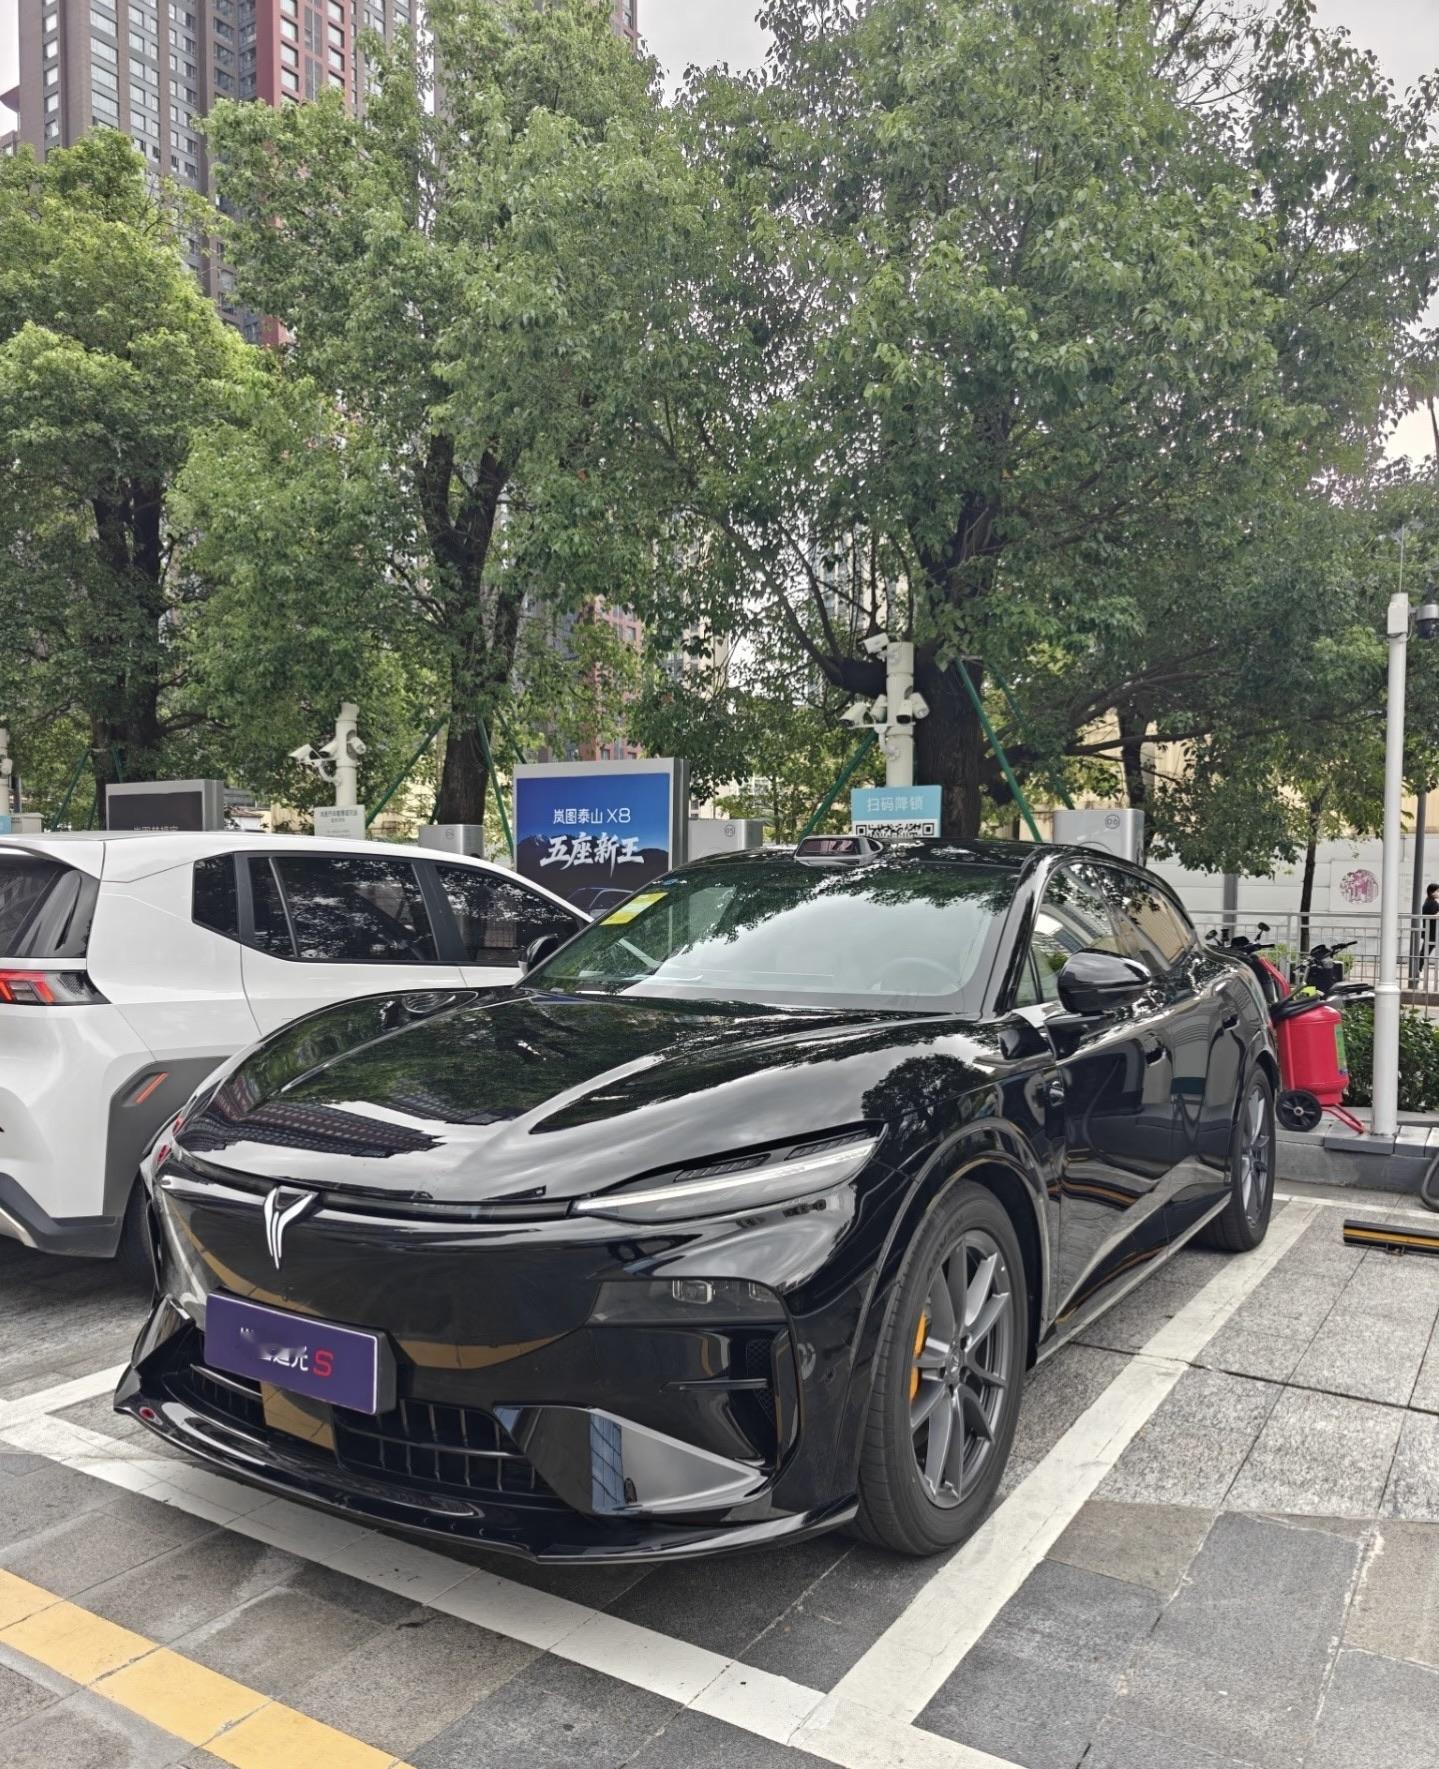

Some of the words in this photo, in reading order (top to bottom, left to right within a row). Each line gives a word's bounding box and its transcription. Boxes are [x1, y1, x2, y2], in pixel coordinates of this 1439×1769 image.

[867, 795, 924, 812] 扫码降锁
[553, 808, 603, 824] 岚图泰山
[607, 807, 631, 823] X8
[540, 831, 645, 878] 五座新王
[313, 1350, 334, 1377] S
